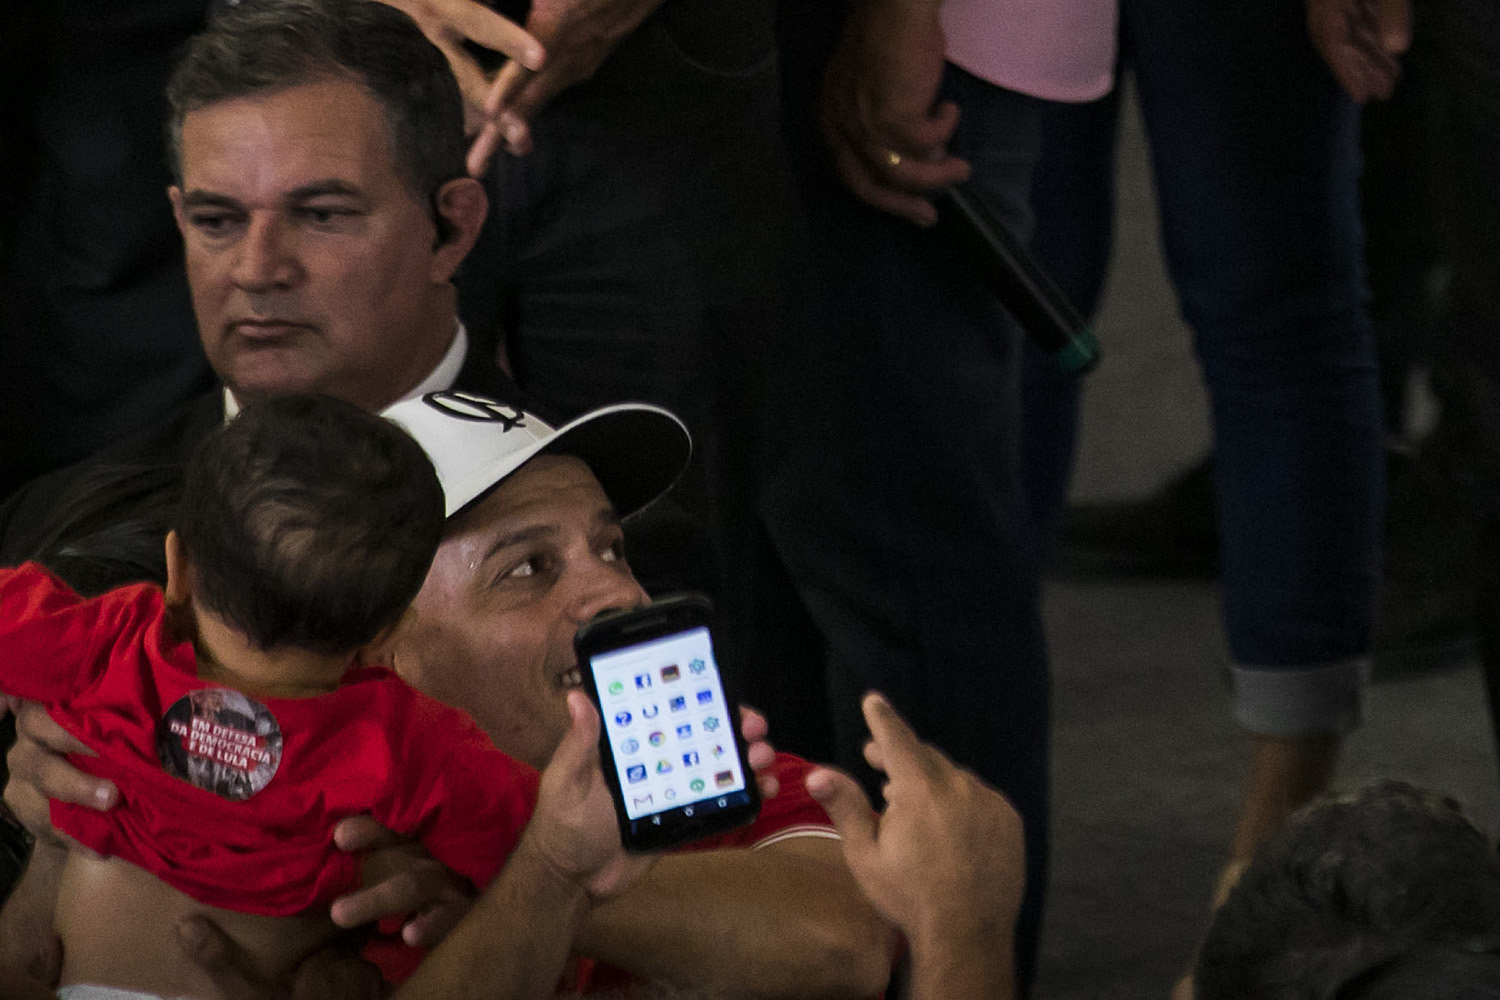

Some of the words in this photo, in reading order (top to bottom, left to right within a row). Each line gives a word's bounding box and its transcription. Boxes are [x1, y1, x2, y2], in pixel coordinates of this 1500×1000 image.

[170, 722, 188, 738] DA
[190, 730, 271, 765] DEMOCRACIA
[191, 717, 211, 733] EM
[213, 724, 257, 748] DEFESA
[190, 740, 196, 751] E
[198, 744, 214, 756] DE
[216, 750, 248, 770] LULA
